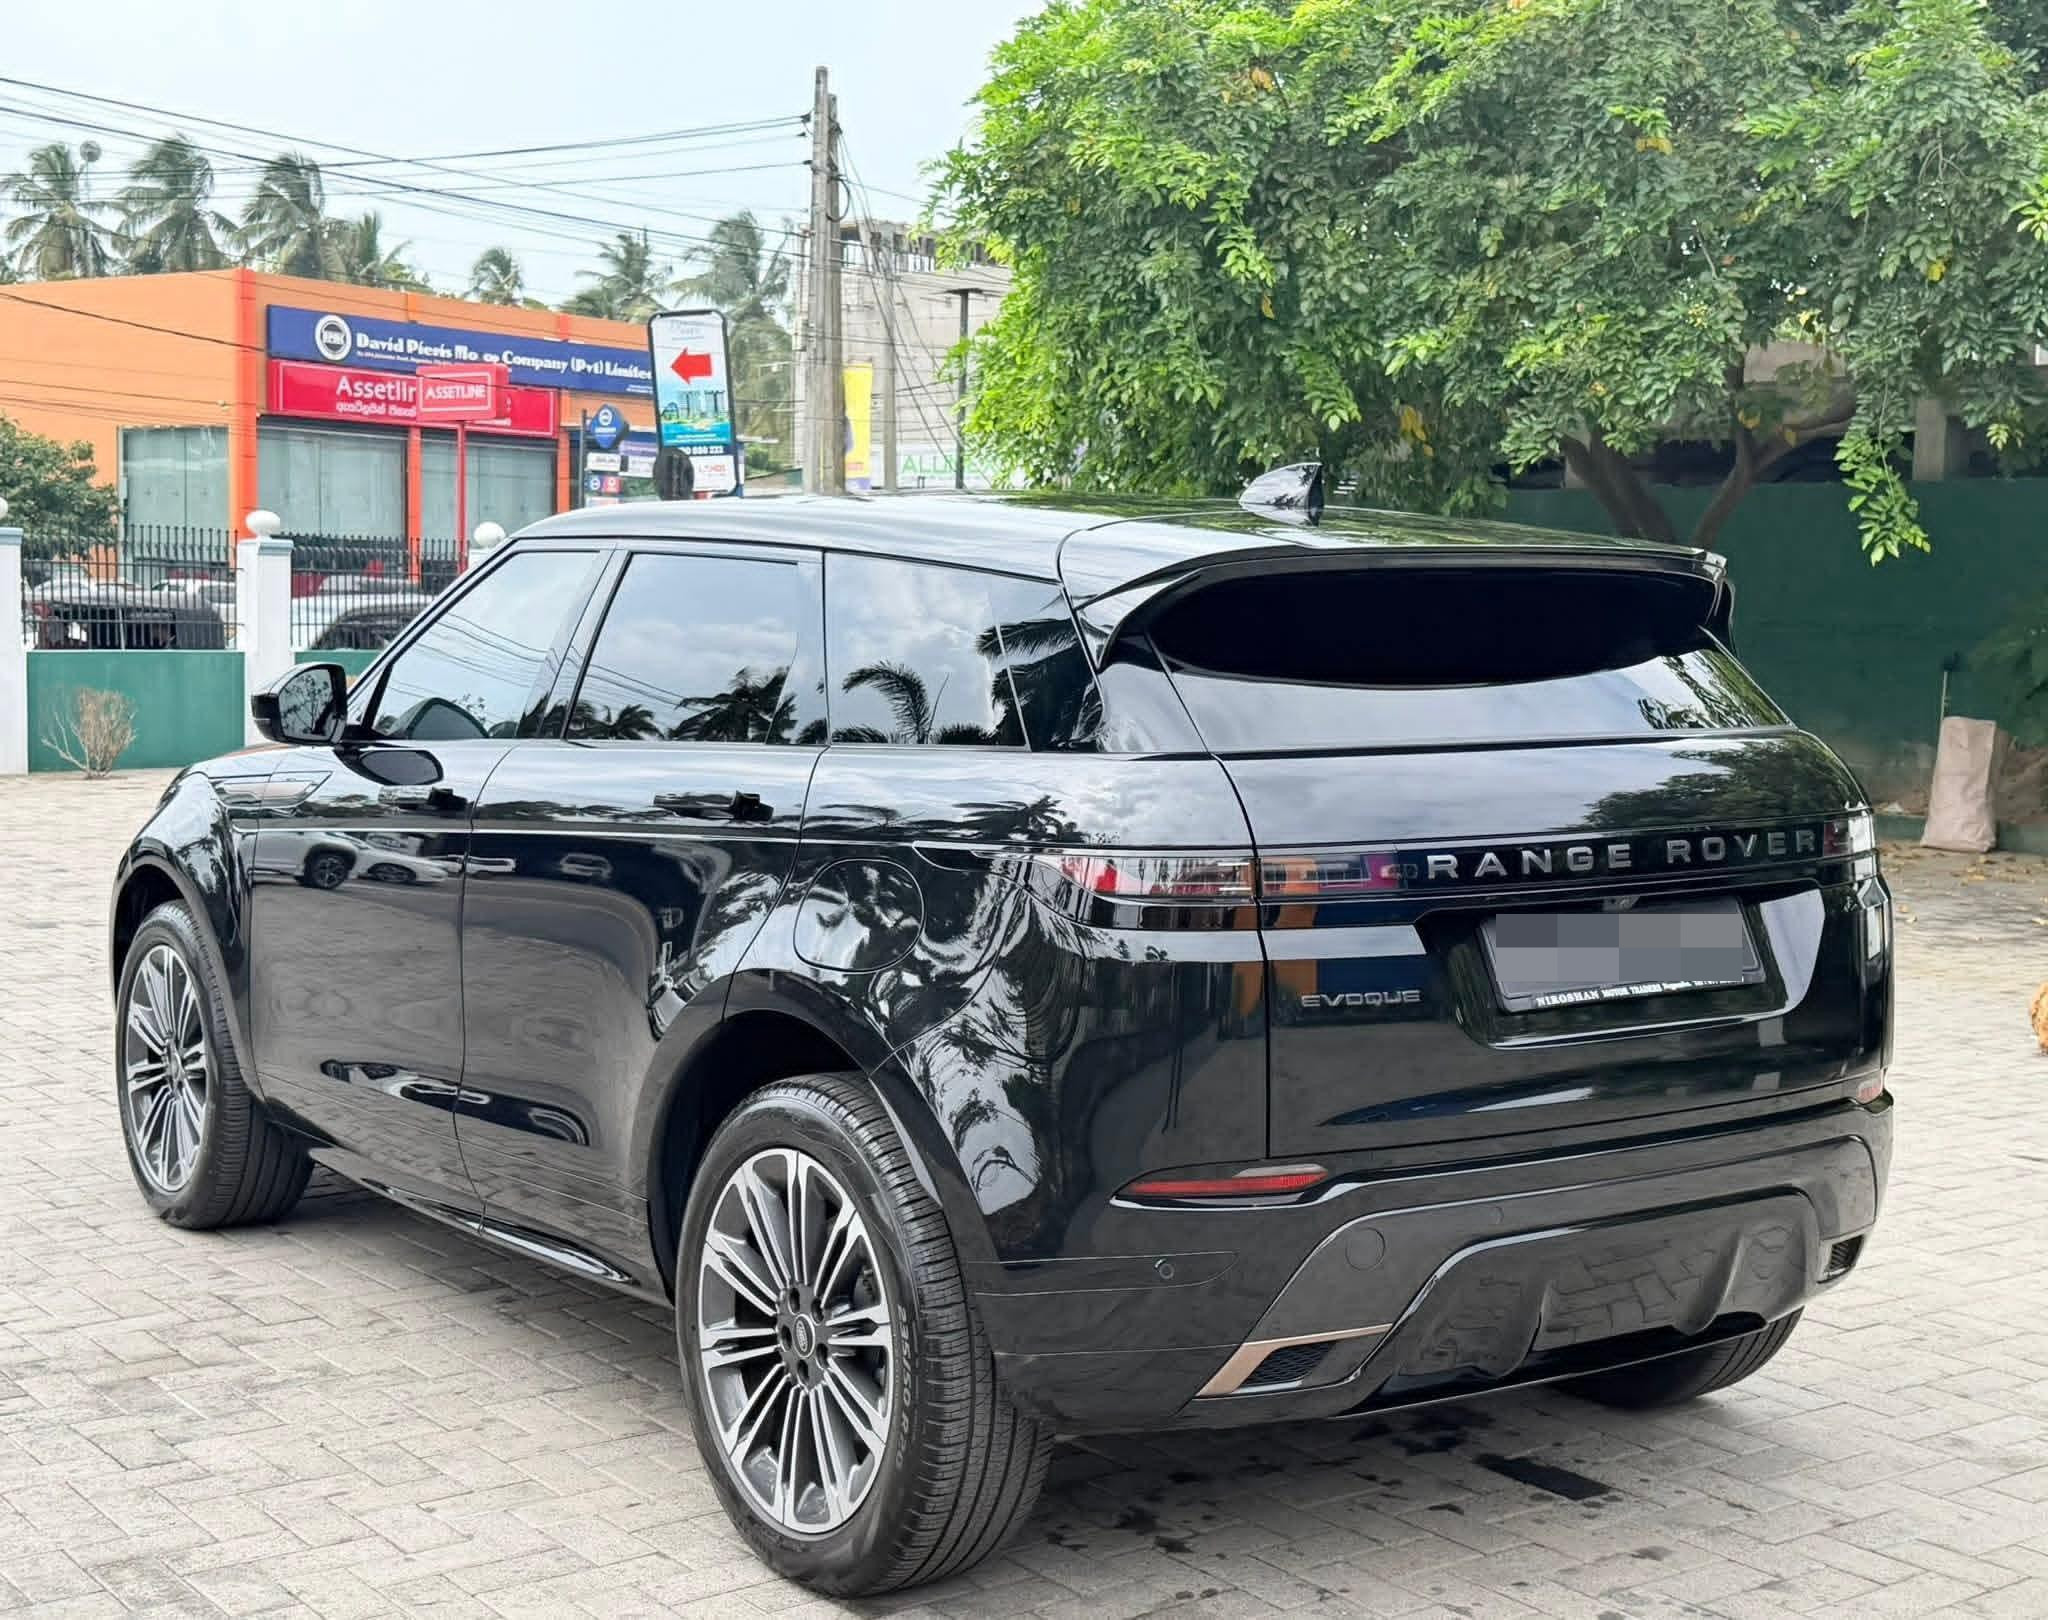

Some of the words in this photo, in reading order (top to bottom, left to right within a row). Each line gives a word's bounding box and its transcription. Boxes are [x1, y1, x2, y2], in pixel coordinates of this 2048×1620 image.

[356, 332, 404, 353] David
[406, 339, 453, 359] Pieris
[502, 350, 569, 374] Company
[571, 356, 604, 374] (Pvt)
[425, 383, 486, 400] ASSETLINE
[1426, 843, 1634, 881] RANGE
[1665, 829, 1817, 865] ROVER
[1301, 989, 1421, 1008] EVOQUE
[1535, 990, 1600, 1007] NIROSHAN
